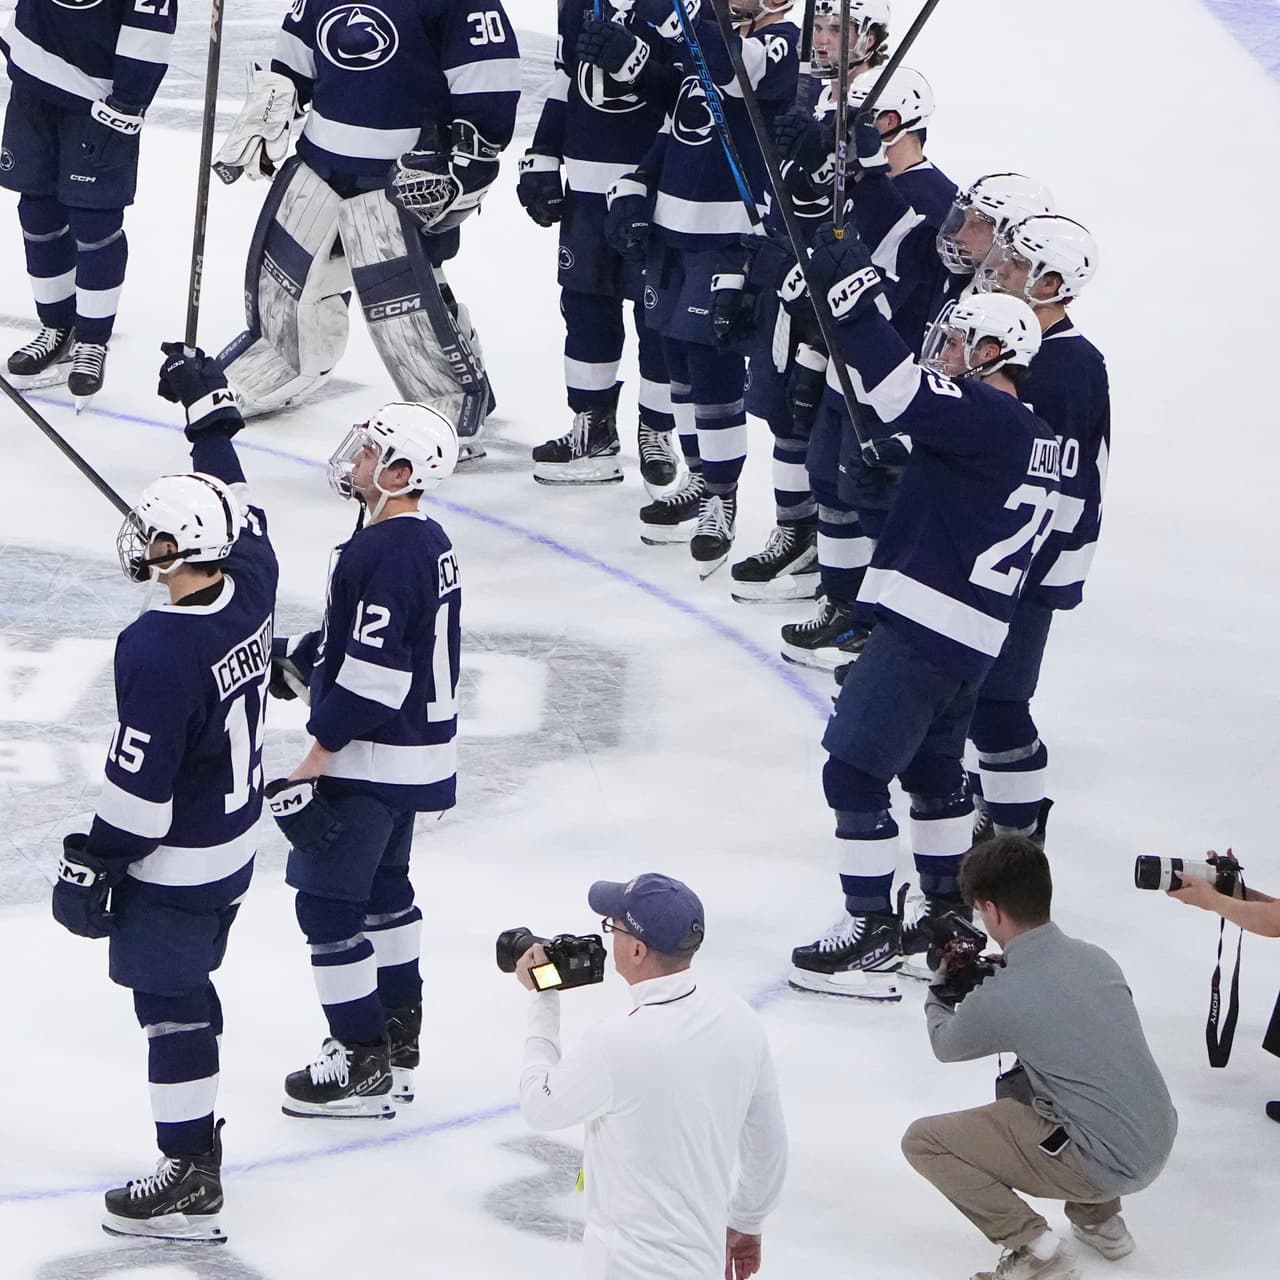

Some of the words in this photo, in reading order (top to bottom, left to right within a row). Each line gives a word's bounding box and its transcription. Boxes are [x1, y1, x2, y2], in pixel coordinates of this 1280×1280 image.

[468, 11, 505, 46] 30
[687, 36, 723, 126] JETSPEED
[99, 109, 137, 132] CCM
[70, 174, 97, 183] CCM
[830, 271, 877, 310] CCM
[370, 297, 421, 320] CCM
[443, 344, 472, 387] 1909
[969, 484, 1050, 598] 2
[352, 605, 392, 649] 12
[107, 721, 152, 775] 15
[271, 792, 304, 815] CM
[847, 941, 891, 970] CCM
[165, 1185, 207, 1218] CCM
